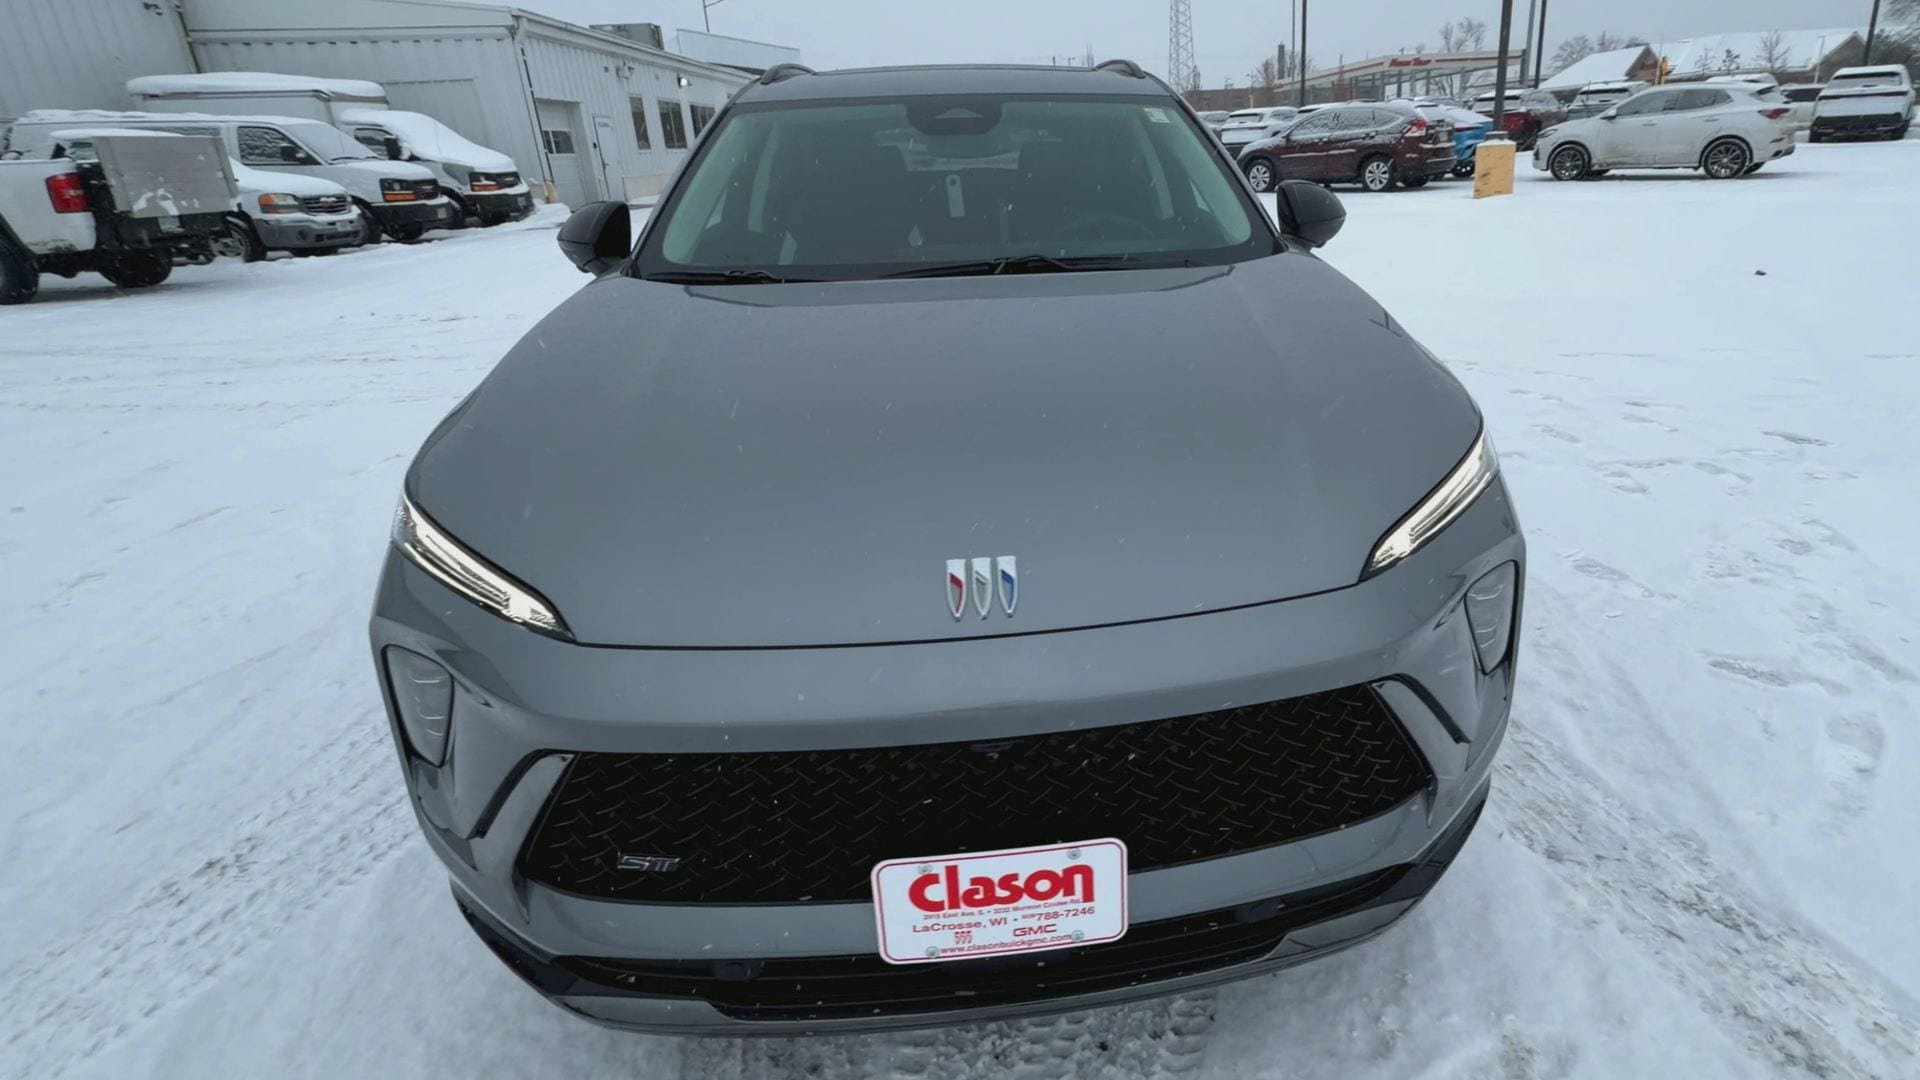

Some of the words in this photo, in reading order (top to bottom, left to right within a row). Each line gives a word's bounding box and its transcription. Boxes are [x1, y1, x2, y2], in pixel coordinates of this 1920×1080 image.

[908, 864, 1095, 912] Clason
[989, 917, 1008, 927] WI
[1013, 923, 1057, 937] GMC
[940, 934, 1074, 954] www.clasonbuickgmc.com
